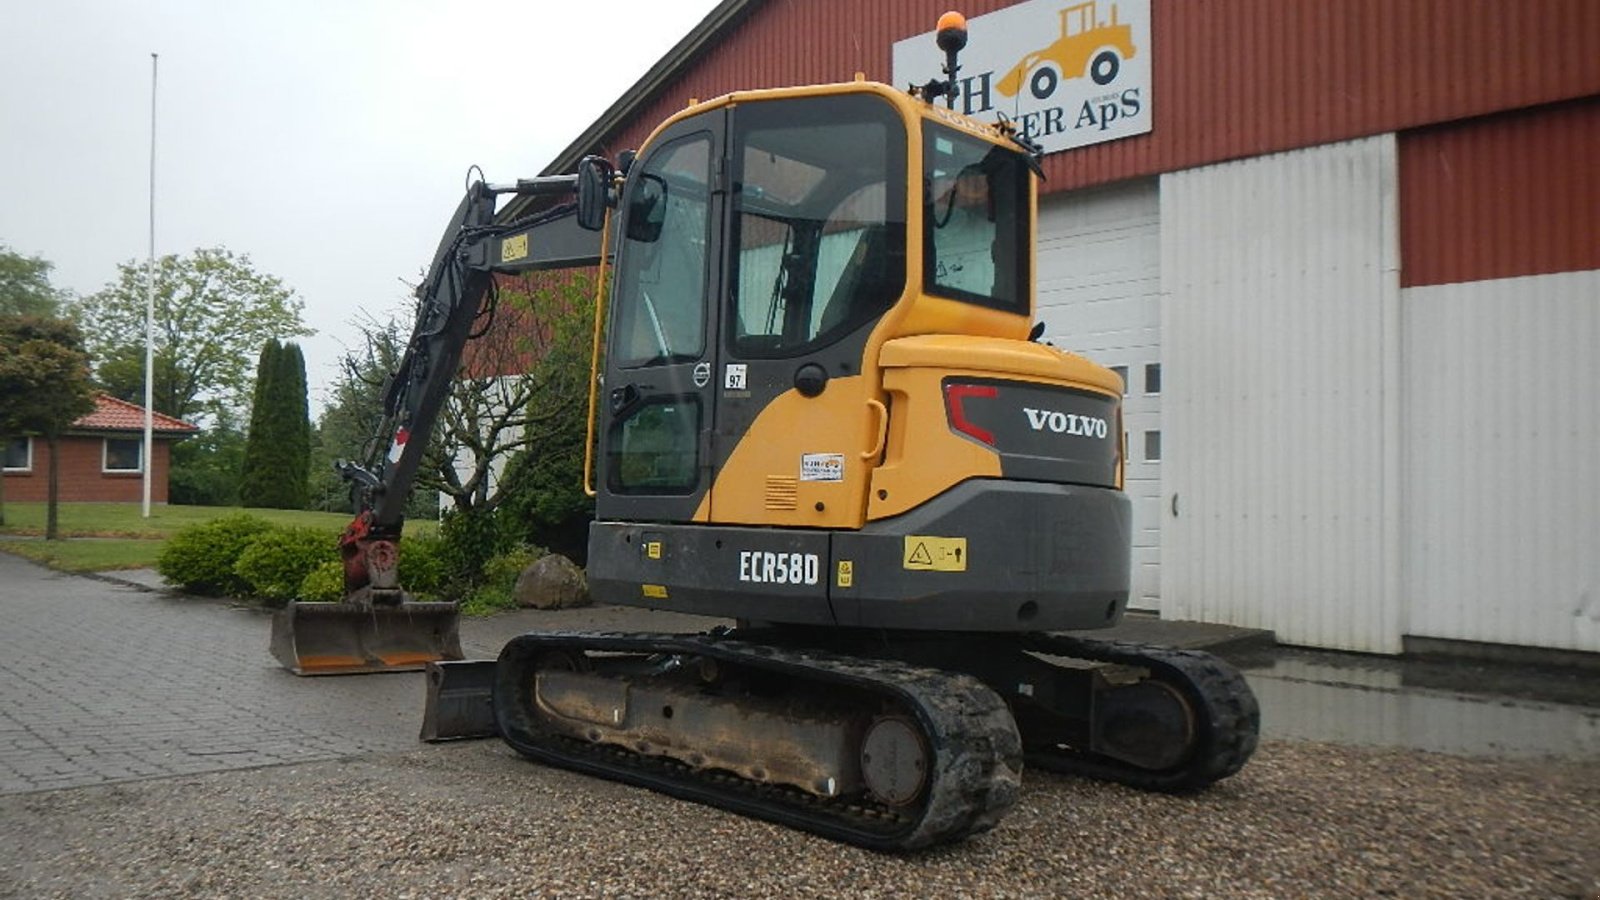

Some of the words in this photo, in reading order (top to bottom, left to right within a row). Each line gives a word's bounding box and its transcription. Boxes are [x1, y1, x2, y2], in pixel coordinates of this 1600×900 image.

[1075, 88, 1140, 130] ApS
[729, 374, 741, 387] 97
[1023, 408, 1108, 439] VOLVO
[739, 551, 819, 586] ECR58D
